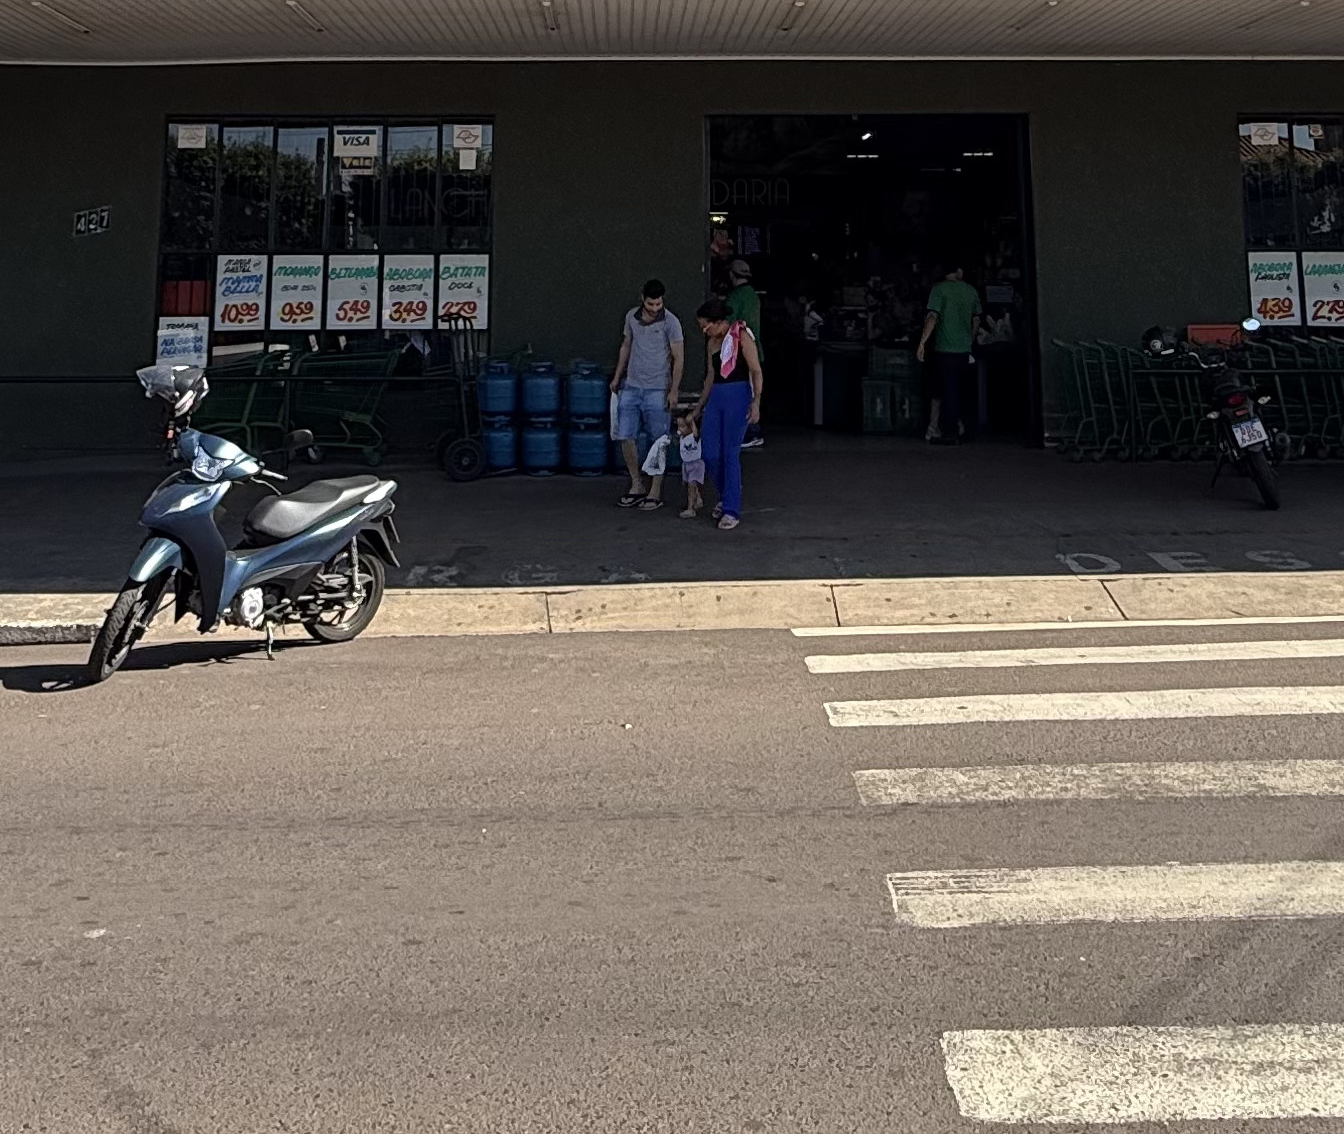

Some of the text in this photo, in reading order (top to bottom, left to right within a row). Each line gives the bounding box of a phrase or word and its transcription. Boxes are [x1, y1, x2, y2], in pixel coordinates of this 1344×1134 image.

[342, 136, 370, 146] VISA
[273, 266, 322, 277] MORANGO
[439, 266, 487, 279] BATATA
[221, 284, 260, 297] BELLA
[448, 282, 474, 291] DOCE
